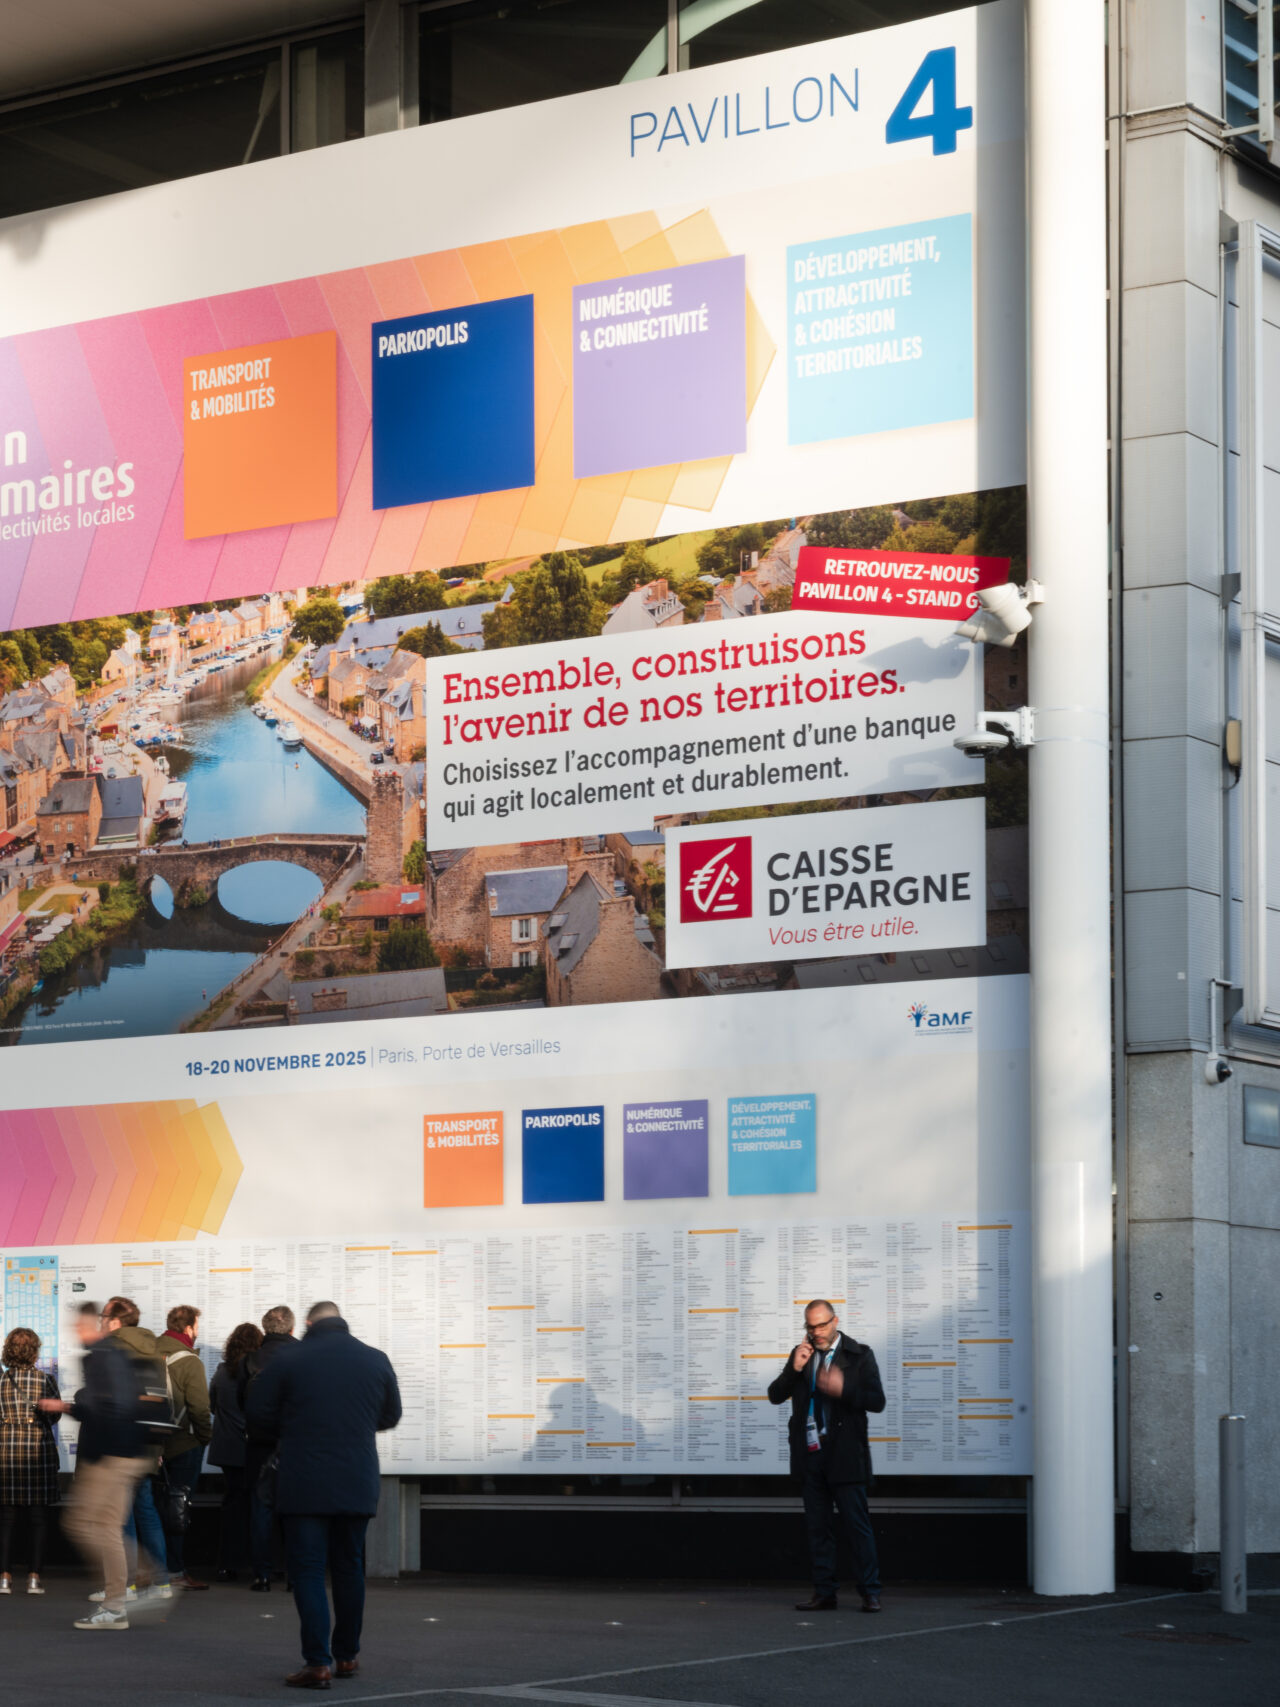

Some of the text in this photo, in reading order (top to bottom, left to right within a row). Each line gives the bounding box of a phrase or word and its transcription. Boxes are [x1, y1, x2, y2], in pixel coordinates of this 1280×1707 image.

[630, 46, 973, 158] PAVILLON 4
[794, 235, 941, 283] DÉVELOPPEMENT,
[579, 283, 673, 321] NUMÉRIQUE
[794, 268, 913, 315] ATTRACTIVITÉ
[378, 320, 469, 358] PARKOPOLIS
[579, 304, 709, 352] & CONNECTIVITÉ
[795, 307, 896, 346] & COHÉSION
[190, 357, 272, 391] TRANSPORT
[795, 336, 923, 378] TERRITORIALES
[190, 385, 275, 421] & MOBILITÉS
[0, 459, 135, 517] maires
[77, 501, 135, 528] locales
[824, 558, 981, 584] RETROUVEZ-NOUS
[799, 581, 878, 602] PAVILLON
[881, 587, 892, 604] 4
[906, 589, 962, 608] STAND
[965, 592, 983, 610] G
[442, 628, 867, 704] Ensemble, construisons
[442, 667, 906, 745] l'avenir de nos territoires.
[442, 711, 957, 787] Choisissez l'accompagnement d'une banque
[442, 756, 849, 823] qui agit localement et durablement.
[767, 843, 894, 882] CAISSE
[769, 871, 971, 917] D'EPARGNE
[768, 916, 919, 945] Vous être utile.
[185, 1038, 562, 1077] 18-20 NOVEMBRE 2025 Paris, Porte de Versailles
[426, 1118, 498, 1134] TRANSPORT
[525, 1112, 601, 1129] PARKOPOLIS
[626, 1107, 683, 1121] NUMÉRIQUE
[626, 1116, 705, 1134] & CONNECTIVITÉ
[731, 1100, 812, 1115] DÉVELOPPEMENT,
[731, 1111, 797, 1127] ATTRACTIVITÉ
[426, 1131, 500, 1148] & MOBILITÉS
[731, 1125, 787, 1140] & COHÉSION
[731, 1139, 803, 1152] TERRITORIALES
